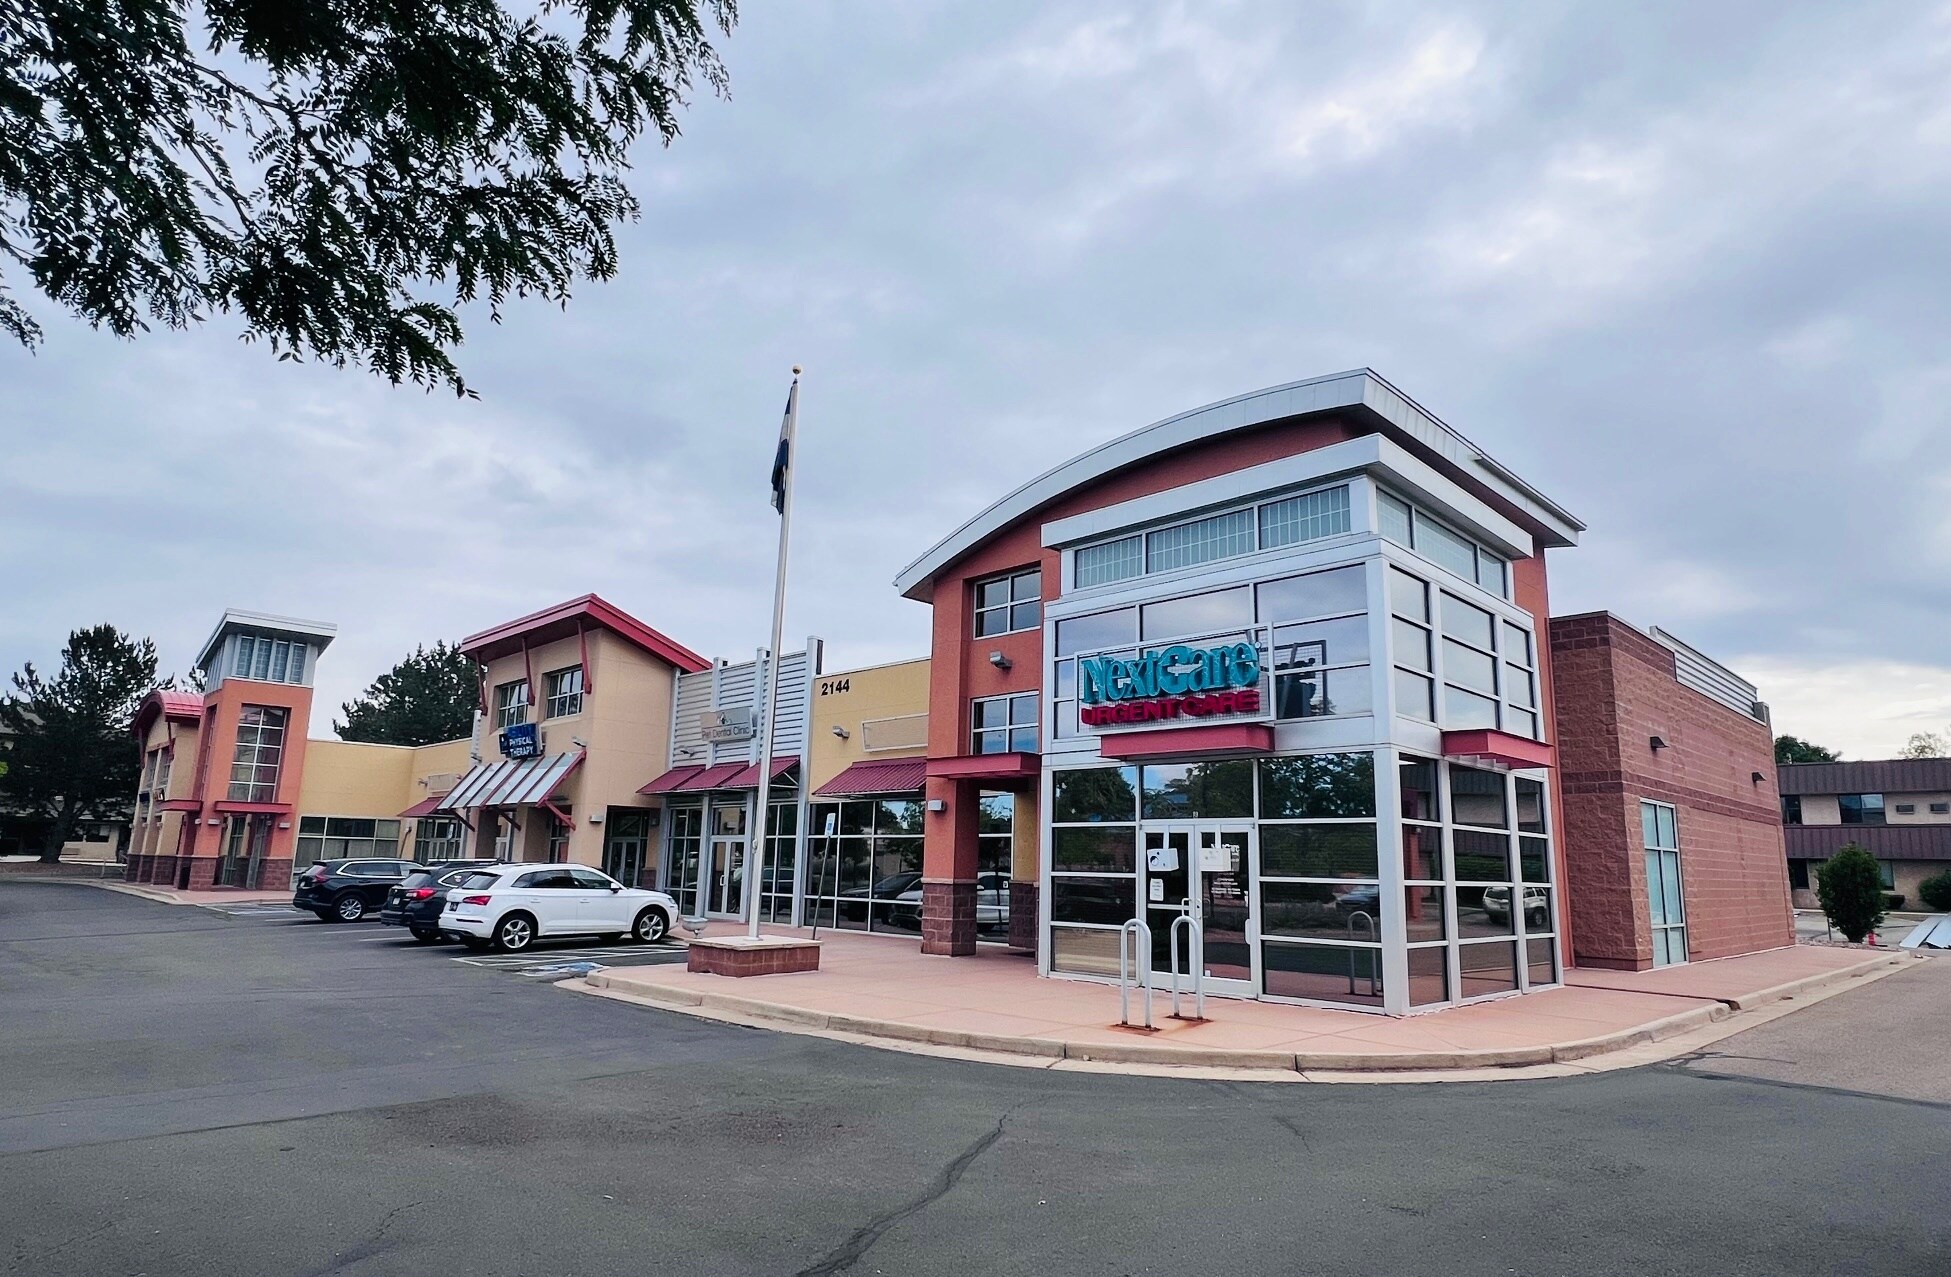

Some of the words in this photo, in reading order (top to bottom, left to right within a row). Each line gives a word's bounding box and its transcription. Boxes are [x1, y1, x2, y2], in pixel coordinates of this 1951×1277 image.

[1081, 642, 1260, 704] NextCare
[820, 678, 849, 696] 2144
[1081, 699, 1182, 726] URGENT
[1181, 689, 1260, 717] CARE
[713, 728, 731, 738] Dental
[733, 726, 750, 736] Clinic
[510, 746, 533, 757] THERAPY
